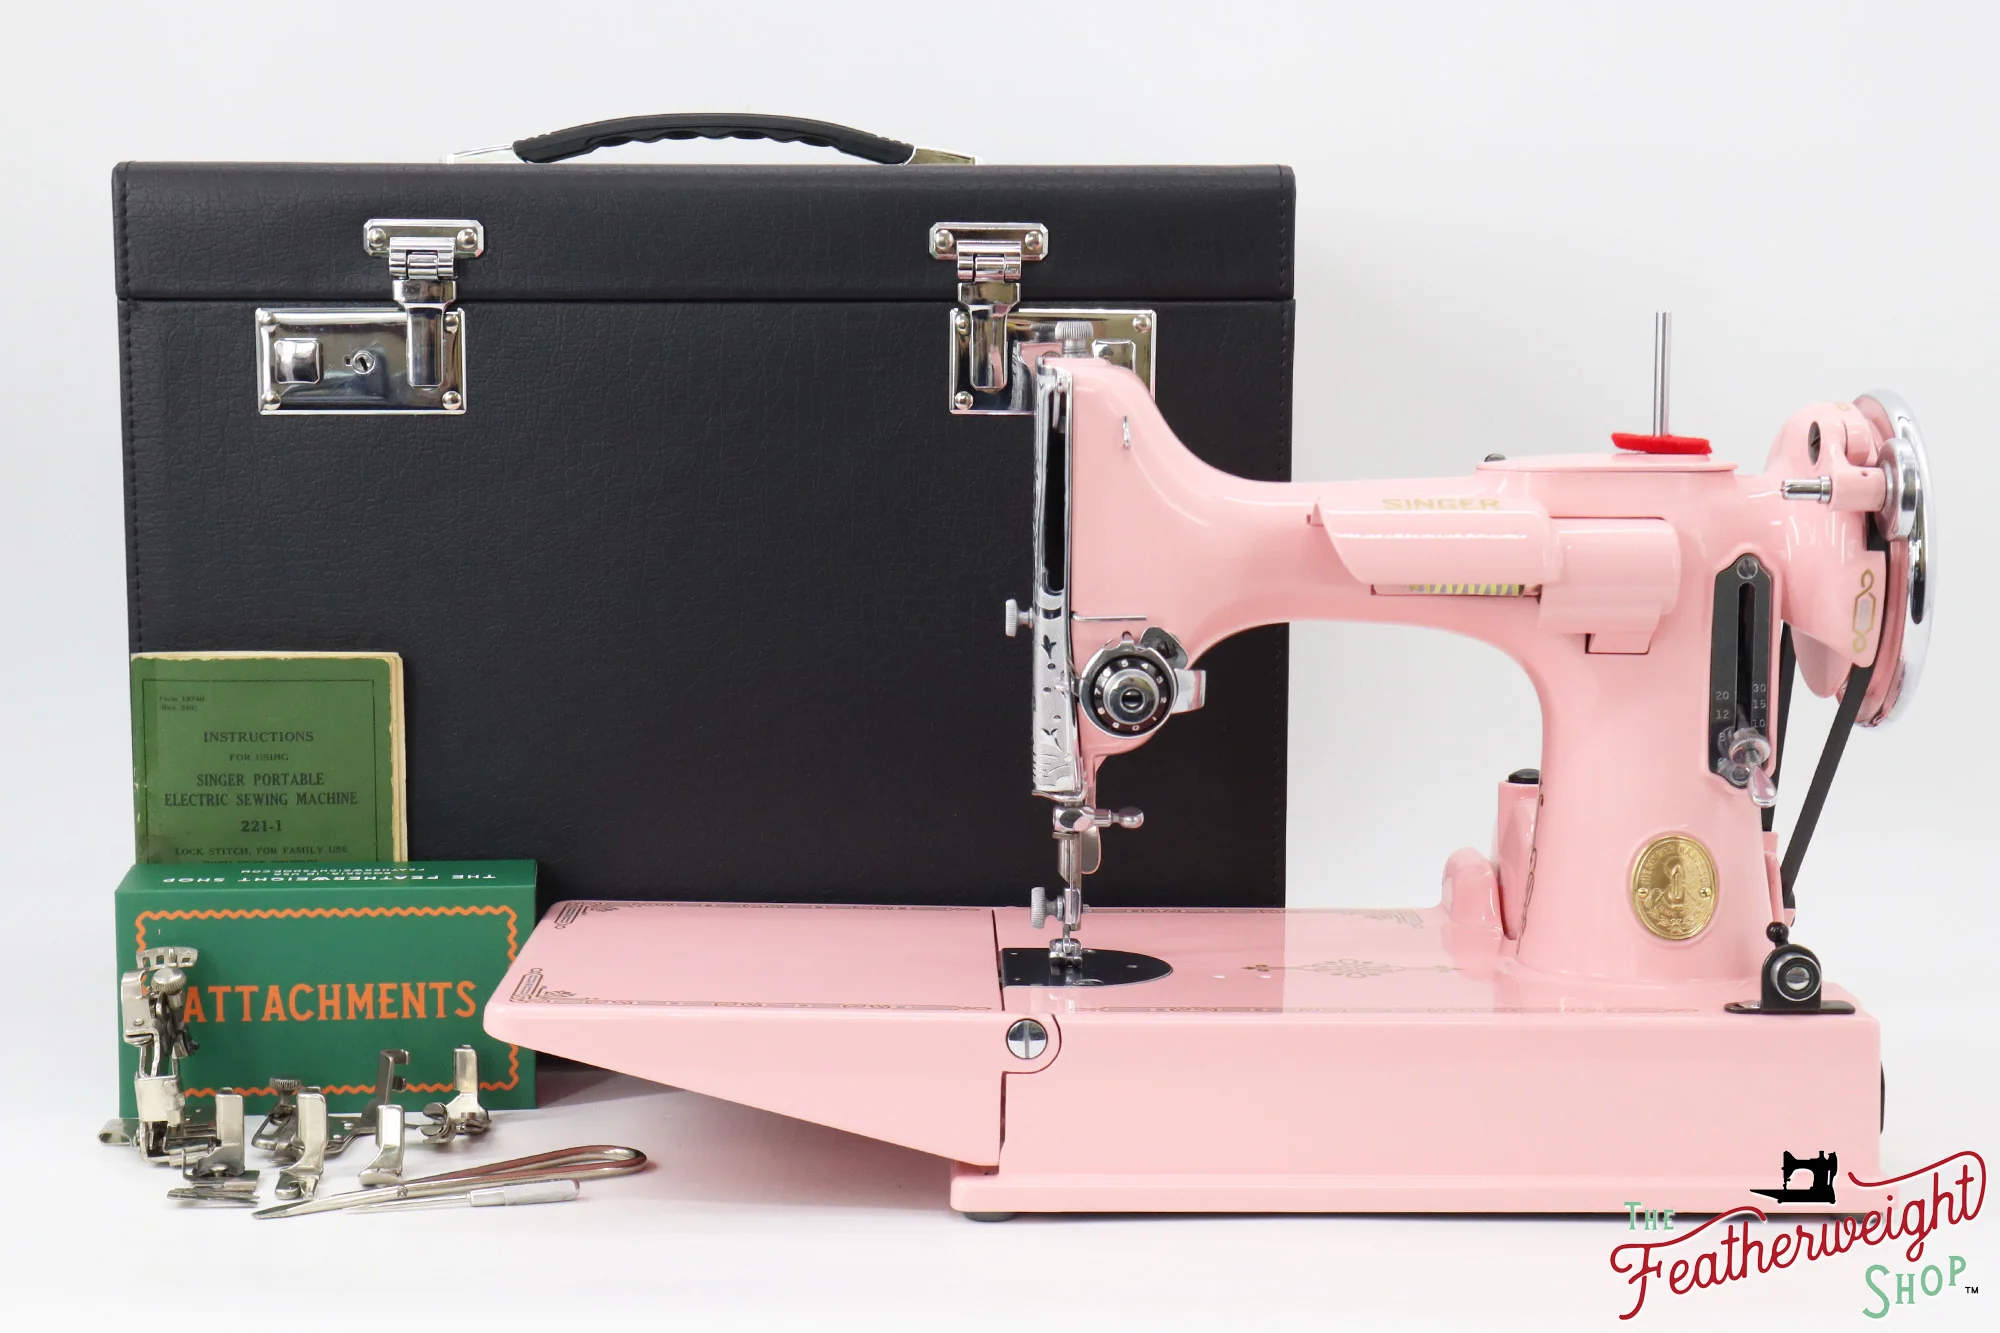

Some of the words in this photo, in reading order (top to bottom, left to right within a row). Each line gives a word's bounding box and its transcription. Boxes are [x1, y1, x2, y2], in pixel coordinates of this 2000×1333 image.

[1382, 498, 1499, 510] SINGER
[1752, 683, 1766, 693] 30
[1716, 691, 1729, 700] 20
[1752, 700, 1766, 709] 15
[1716, 709, 1729, 719] 12
[1752, 719, 1766, 728] 10
[203, 731, 314, 743] INSTRUCTIONS
[229, 753, 251, 761] FOR
[256, 752, 289, 761] USING
[196, 773, 245, 787] SINGER
[253, 772, 325, 786] PORTABLE
[164, 793, 228, 807] ELECTRIC
[236, 792, 288, 806] SEWING
[296, 791, 358, 805] MACHINE
[240, 820, 282, 833] 221-1
[175, 847, 204, 856] LOCK
[256, 847, 277, 855] FOR
[283, 846, 323, 855] FAMILY
[329, 846, 349, 854] USE
[237, 874, 439, 882] FEATHERWEIGHT
[182, 980, 476, 1023] ATTACHMENTS
